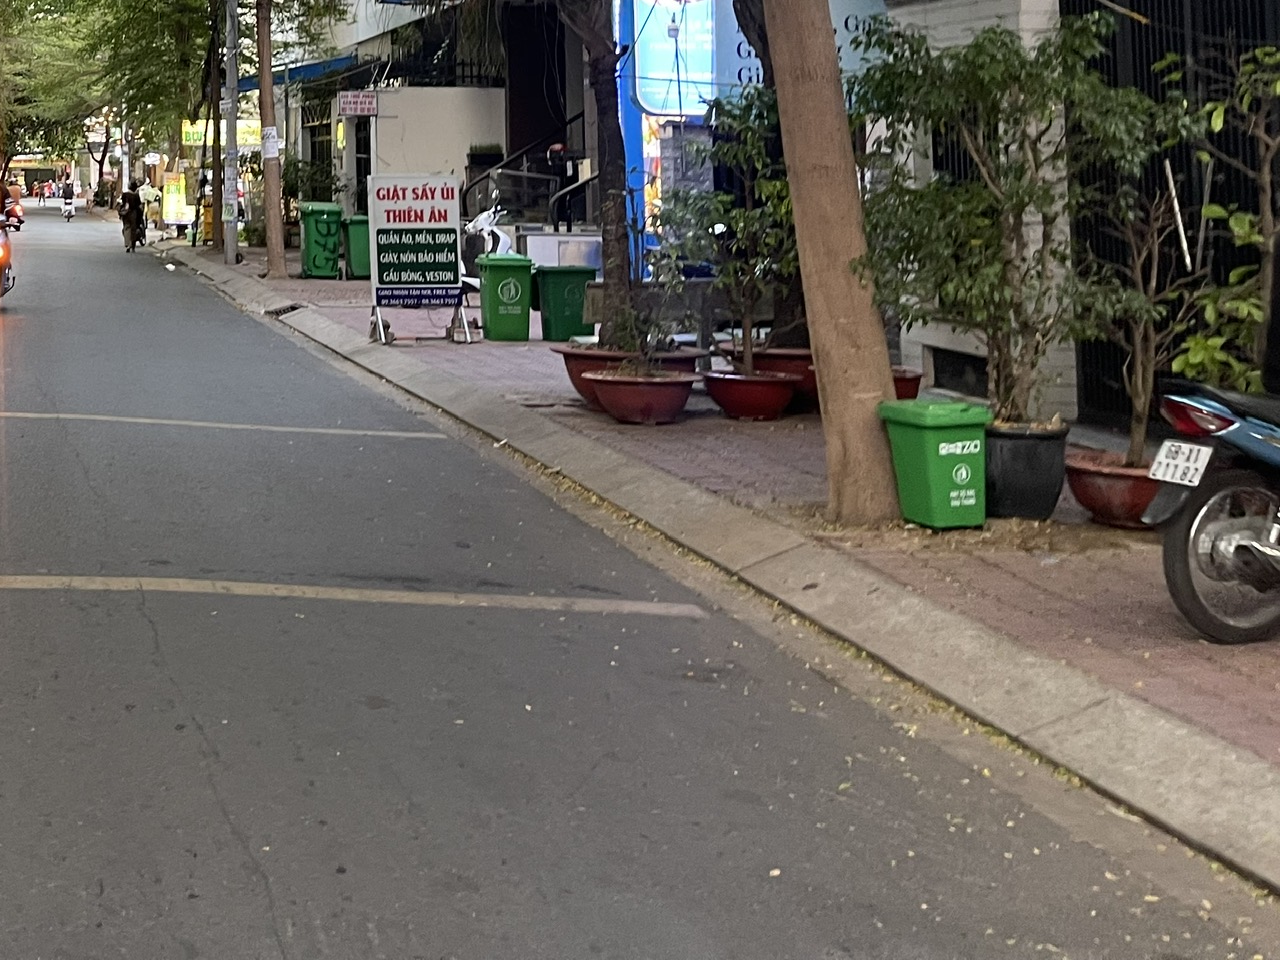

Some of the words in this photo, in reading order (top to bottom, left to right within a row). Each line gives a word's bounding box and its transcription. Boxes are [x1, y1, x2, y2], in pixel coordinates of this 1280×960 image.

[376, 184, 408, 204] GIẶT
[412, 182, 437, 201] SẤY
[441, 182, 455, 201] ỦI
[384, 205, 424, 223] THIÊN
[428, 205, 448, 223] ÂN
[425, 271, 454, 282] VESTON
